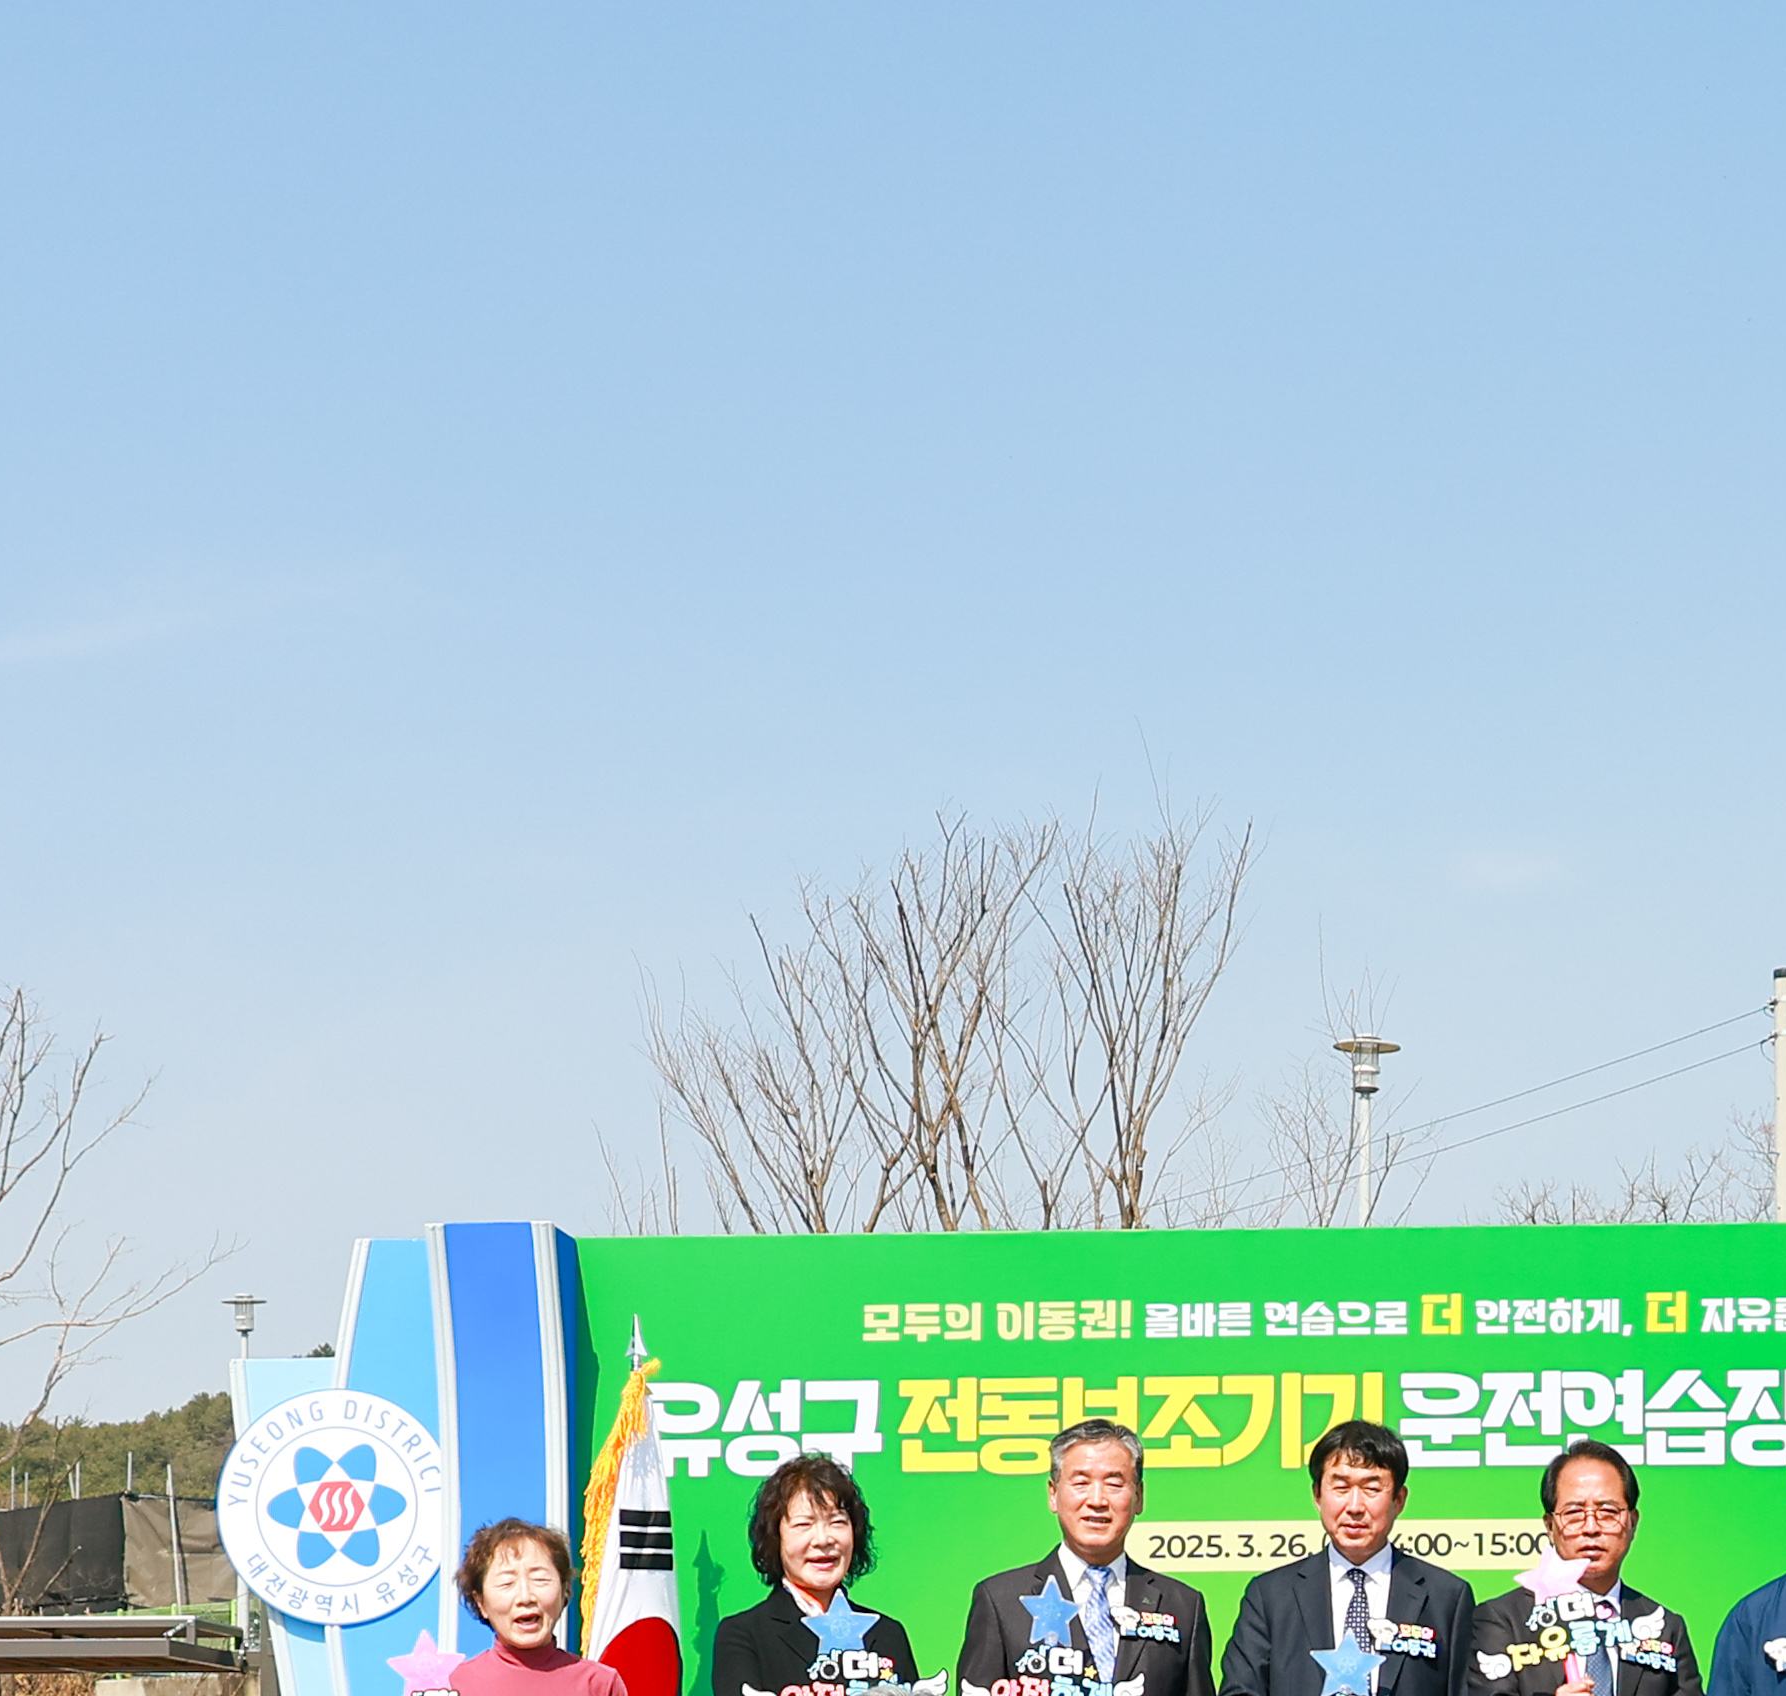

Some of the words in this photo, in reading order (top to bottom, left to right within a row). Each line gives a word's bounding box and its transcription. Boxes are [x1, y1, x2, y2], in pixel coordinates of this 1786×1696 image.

[862, 1302, 983, 1342] 모두의
[996, 1300, 1133, 1340] 이동권!
[1144, 1301, 1253, 1337] 올바른
[1264, 1301, 1408, 1336] 연습으로
[1420, 1293, 1463, 1335] 더
[1474, 1297, 1634, 1337] 안전하게,
[1645, 1291, 1688, 1333] 더
[227, 1401, 324, 1507] YUSEONG
[646, 1379, 883, 1478] 유성구
[1149, 1534, 1230, 1560] 2025.
[1238, 1533, 1262, 1559] 3.
[247, 1553, 360, 1616] 대전광역시
[375, 1545, 434, 1604] 유성구
[1557, 1592, 1594, 1621] 더
[842, 1650, 879, 1679] 더
[1049, 1647, 1084, 1675] 더
[1507, 1617, 1632, 1672] 자유롭게
